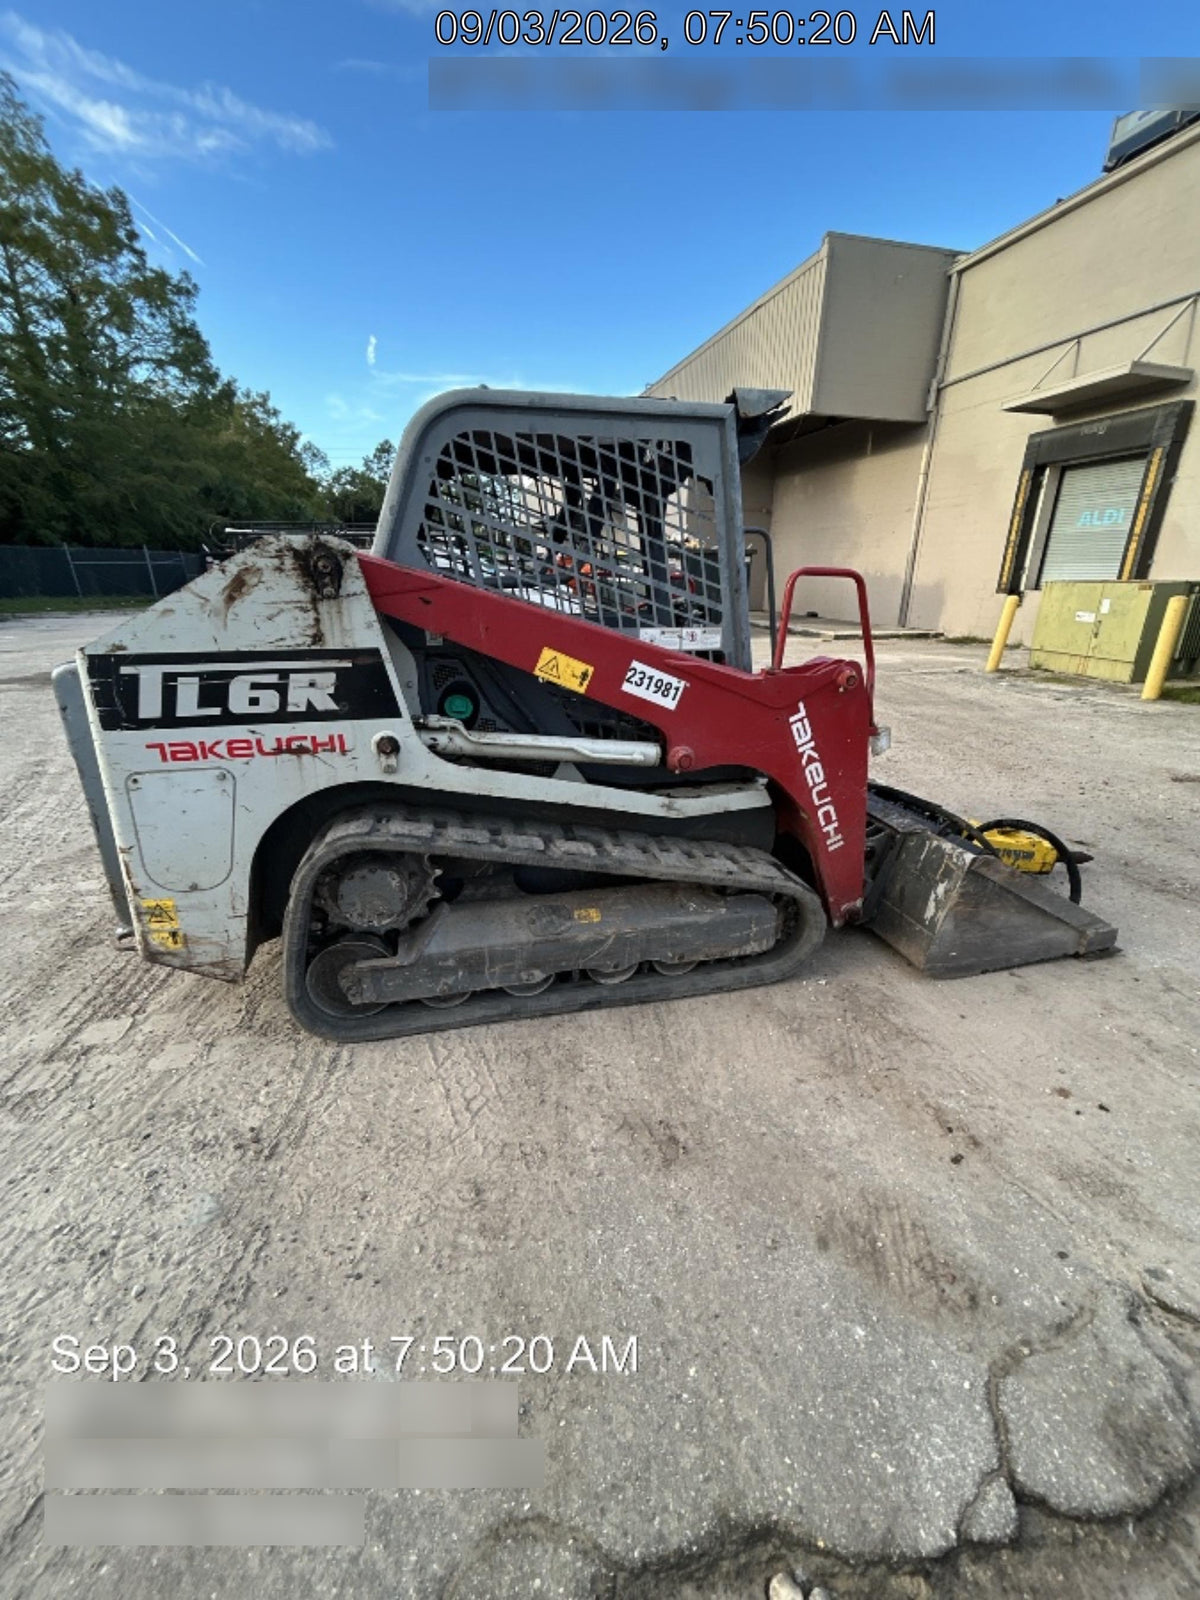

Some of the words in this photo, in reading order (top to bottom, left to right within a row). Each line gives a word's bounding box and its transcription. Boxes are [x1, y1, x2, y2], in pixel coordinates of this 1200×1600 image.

[1076, 508, 1125, 528] ALDI
[120, 661, 353, 719] TL6R
[625, 667, 681, 701] 231981
